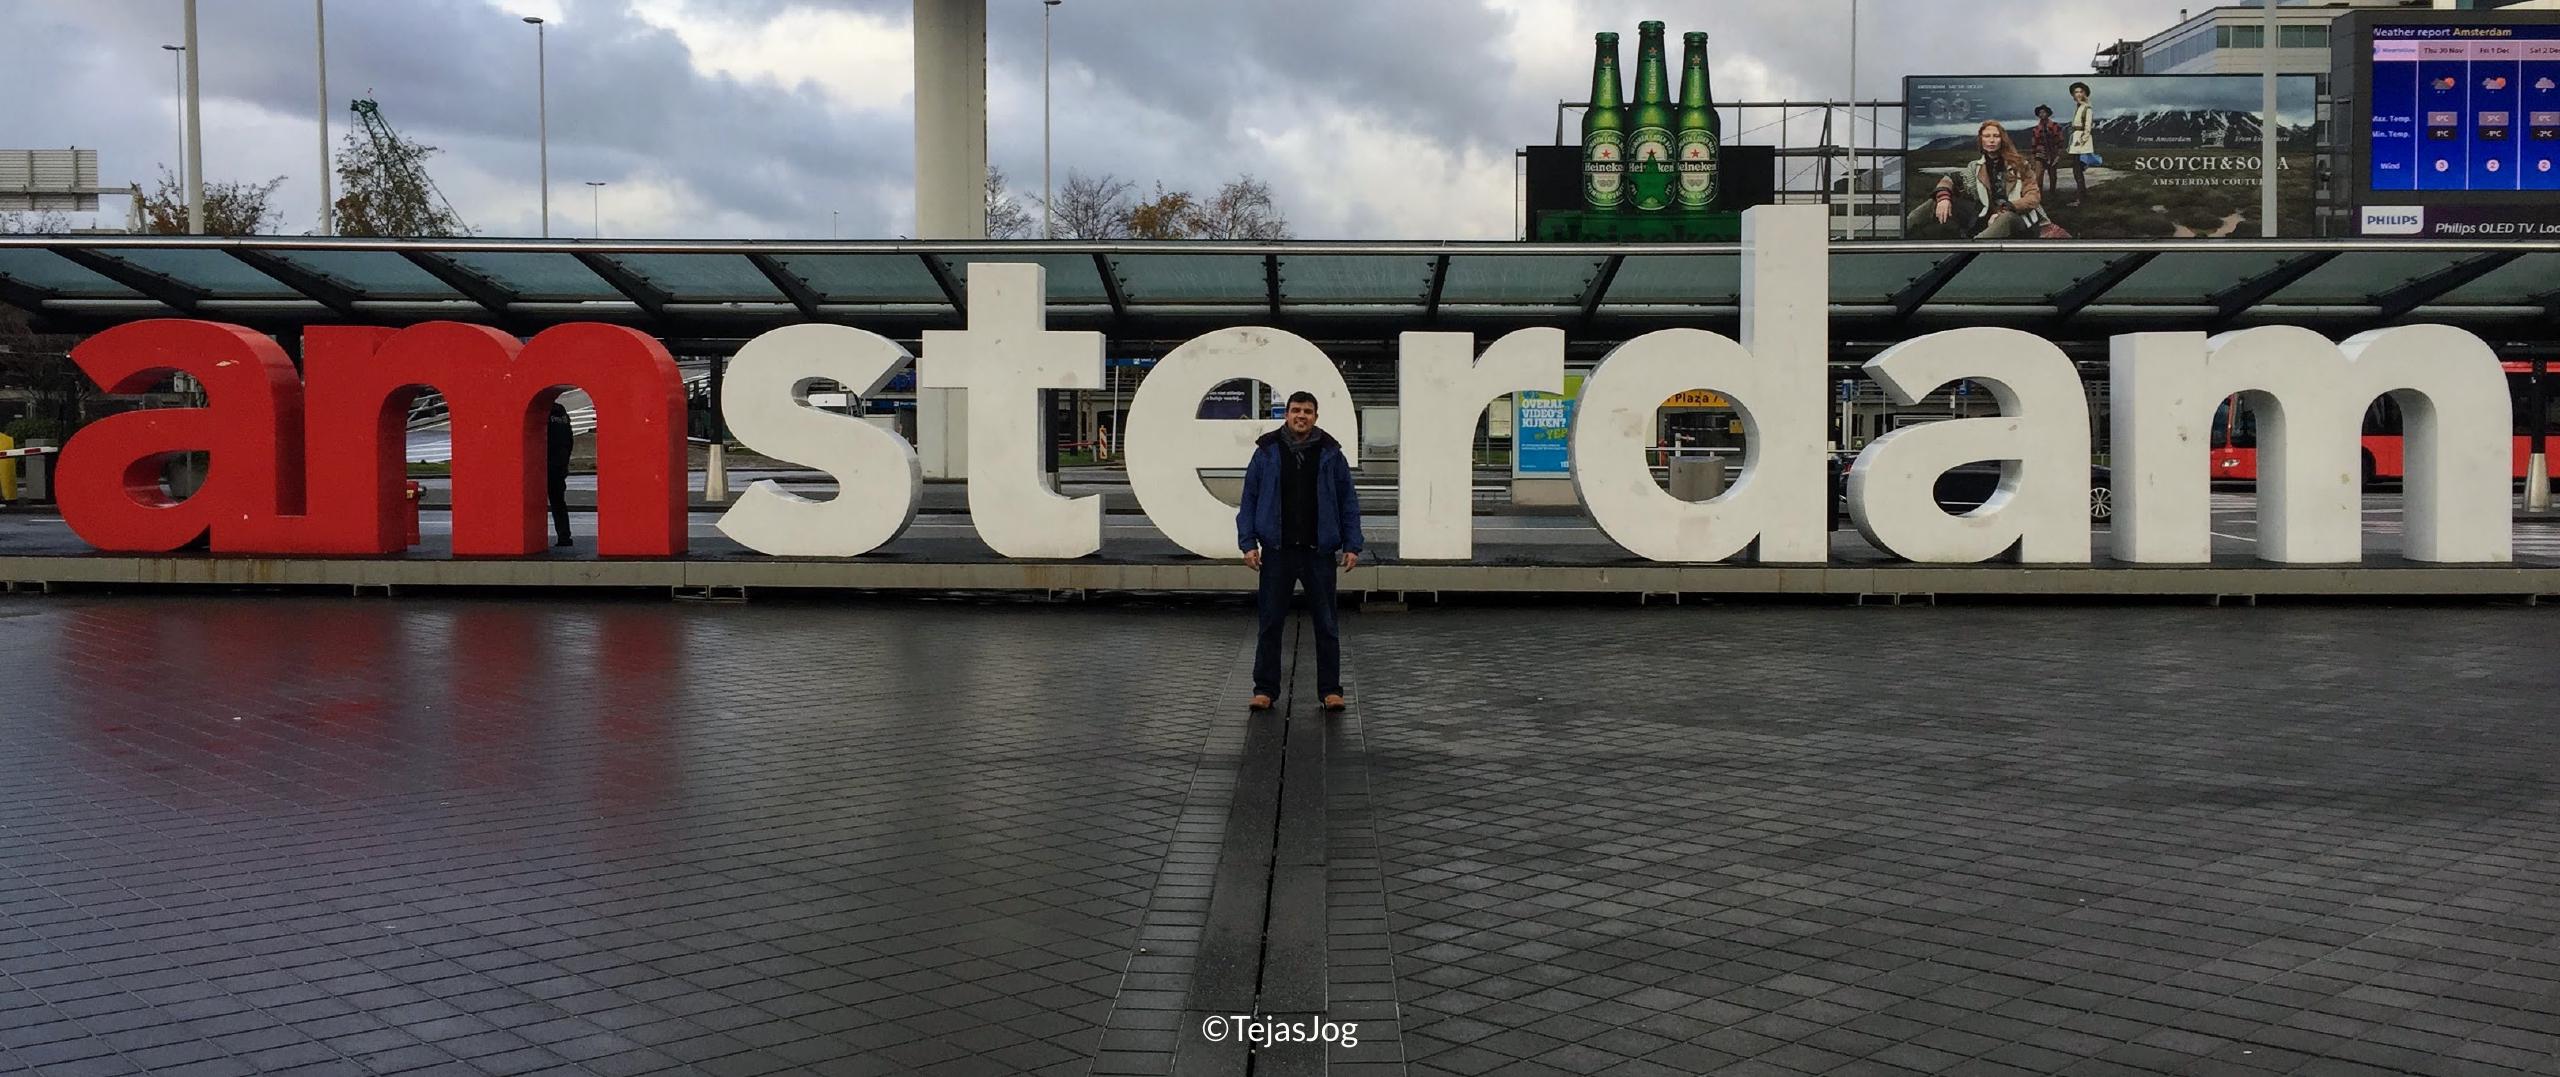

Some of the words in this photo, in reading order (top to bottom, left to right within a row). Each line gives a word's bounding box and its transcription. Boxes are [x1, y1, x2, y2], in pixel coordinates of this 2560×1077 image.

[2417, 27, 2451, 39] report
[2452, 27, 2513, 37] Amsterdam
[2134, 156, 2217, 171] SCOTCH
[2236, 156, 2290, 171] SOA
[2380, 162, 2401, 170] Wind
[2151, 178, 2219, 186] AMSTERDAM
[2367, 215, 2418, 225] PHILIPS
[2435, 223, 2477, 236] Philips
[2479, 223, 2515, 234] OLED
[2517, 223, 2537, 234] TV.
[1675, 392, 1709, 403] Plaza
[1521, 399, 1564, 409] OVERAL
[1521, 408, 1564, 418] VIDEO'S
[1521, 418, 1567, 428] KIJKEN?
